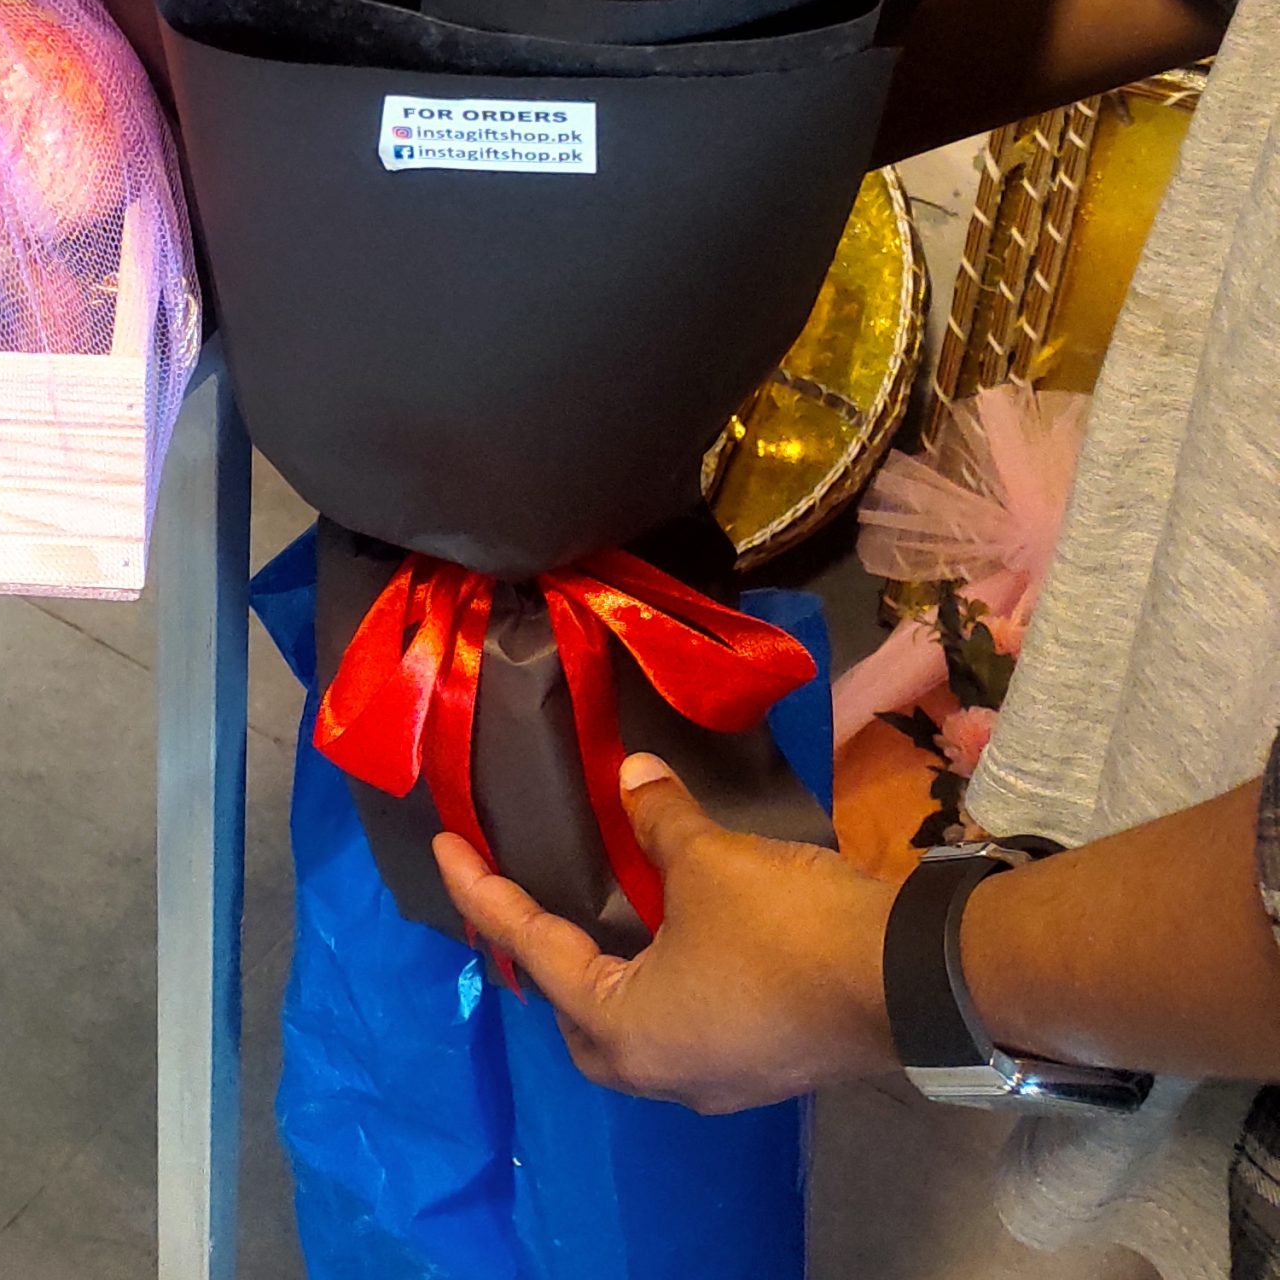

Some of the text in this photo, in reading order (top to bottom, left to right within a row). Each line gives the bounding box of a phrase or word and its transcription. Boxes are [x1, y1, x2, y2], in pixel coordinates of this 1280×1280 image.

[402, 107, 568, 123] FOR ORDERS
[416, 126, 583, 144] instagiftshop.pk
[418, 145, 583, 163] instagiftshop.pk
